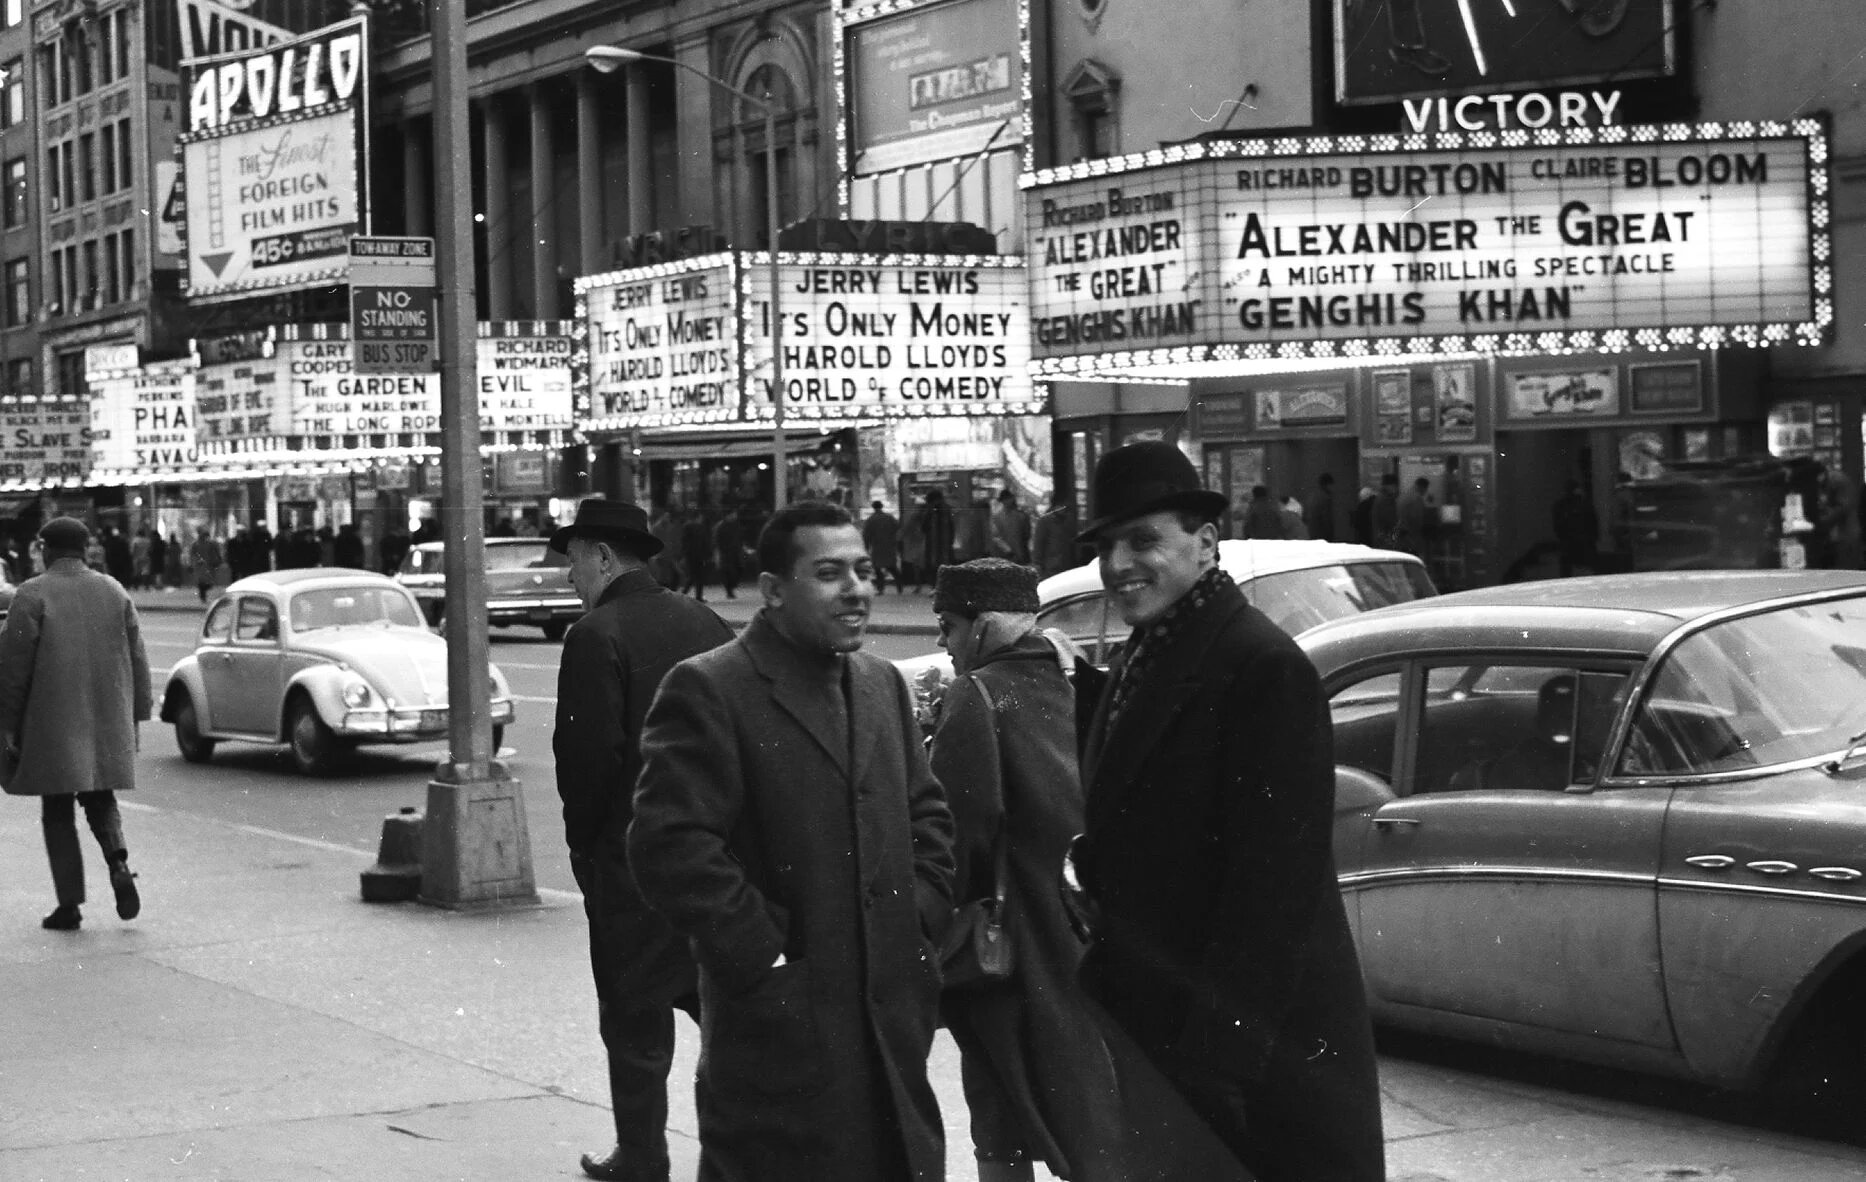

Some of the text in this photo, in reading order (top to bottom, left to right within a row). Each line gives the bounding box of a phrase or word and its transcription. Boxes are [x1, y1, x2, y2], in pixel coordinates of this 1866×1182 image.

[190, 34, 360, 131] APOLLO
[1403, 90, 1621, 132] VICTORY
[240, 172, 328, 203] FOREIGN
[1237, 153, 1768, 198] RICHARD BURTON CLAIRE BLOOM
[242, 195, 339, 231] FILM HITS
[1107, 188, 1173, 217] BURTON
[1495, 215, 1542, 236] THE
[402, 241, 428, 256] ZONE
[795, 269, 979, 295] JERRY LEWIS
[1055, 272, 1082, 292] THE
[1258, 253, 1675, 288] A MIGHTY THRILLING SPECTACLE
[376, 291, 411, 308] NO
[361, 309, 427, 327] STANDING
[626, 317, 663, 351] ONLY
[667, 310, 726, 347] MONEY
[825, 300, 897, 338] ONLY
[303, 344, 347, 358] GARY
[363, 343, 429, 363] BUS STOP
[496, 340, 568, 354] RICHARD
[784, 345, 892, 370] HAROLD
[494, 356, 571, 370] WIDMARK
[610, 356, 664, 383] HAROLD
[301, 379, 328, 397] THE
[337, 377, 427, 396] GARDEN
[481, 375, 533, 393] EVIL
[600, 388, 649, 415] WORLD
[669, 381, 726, 409] COMEDY
[868, 376, 887, 402] OF
[900, 375, 1003, 400] COMEDY
[134, 405, 196, 431] PHA
[316, 402, 352, 414] HUGH
[505, 414, 570, 425] MONTELL
[303, 415, 436, 431] THE LONG ROP
[15, 428, 71, 448] SLAVE
